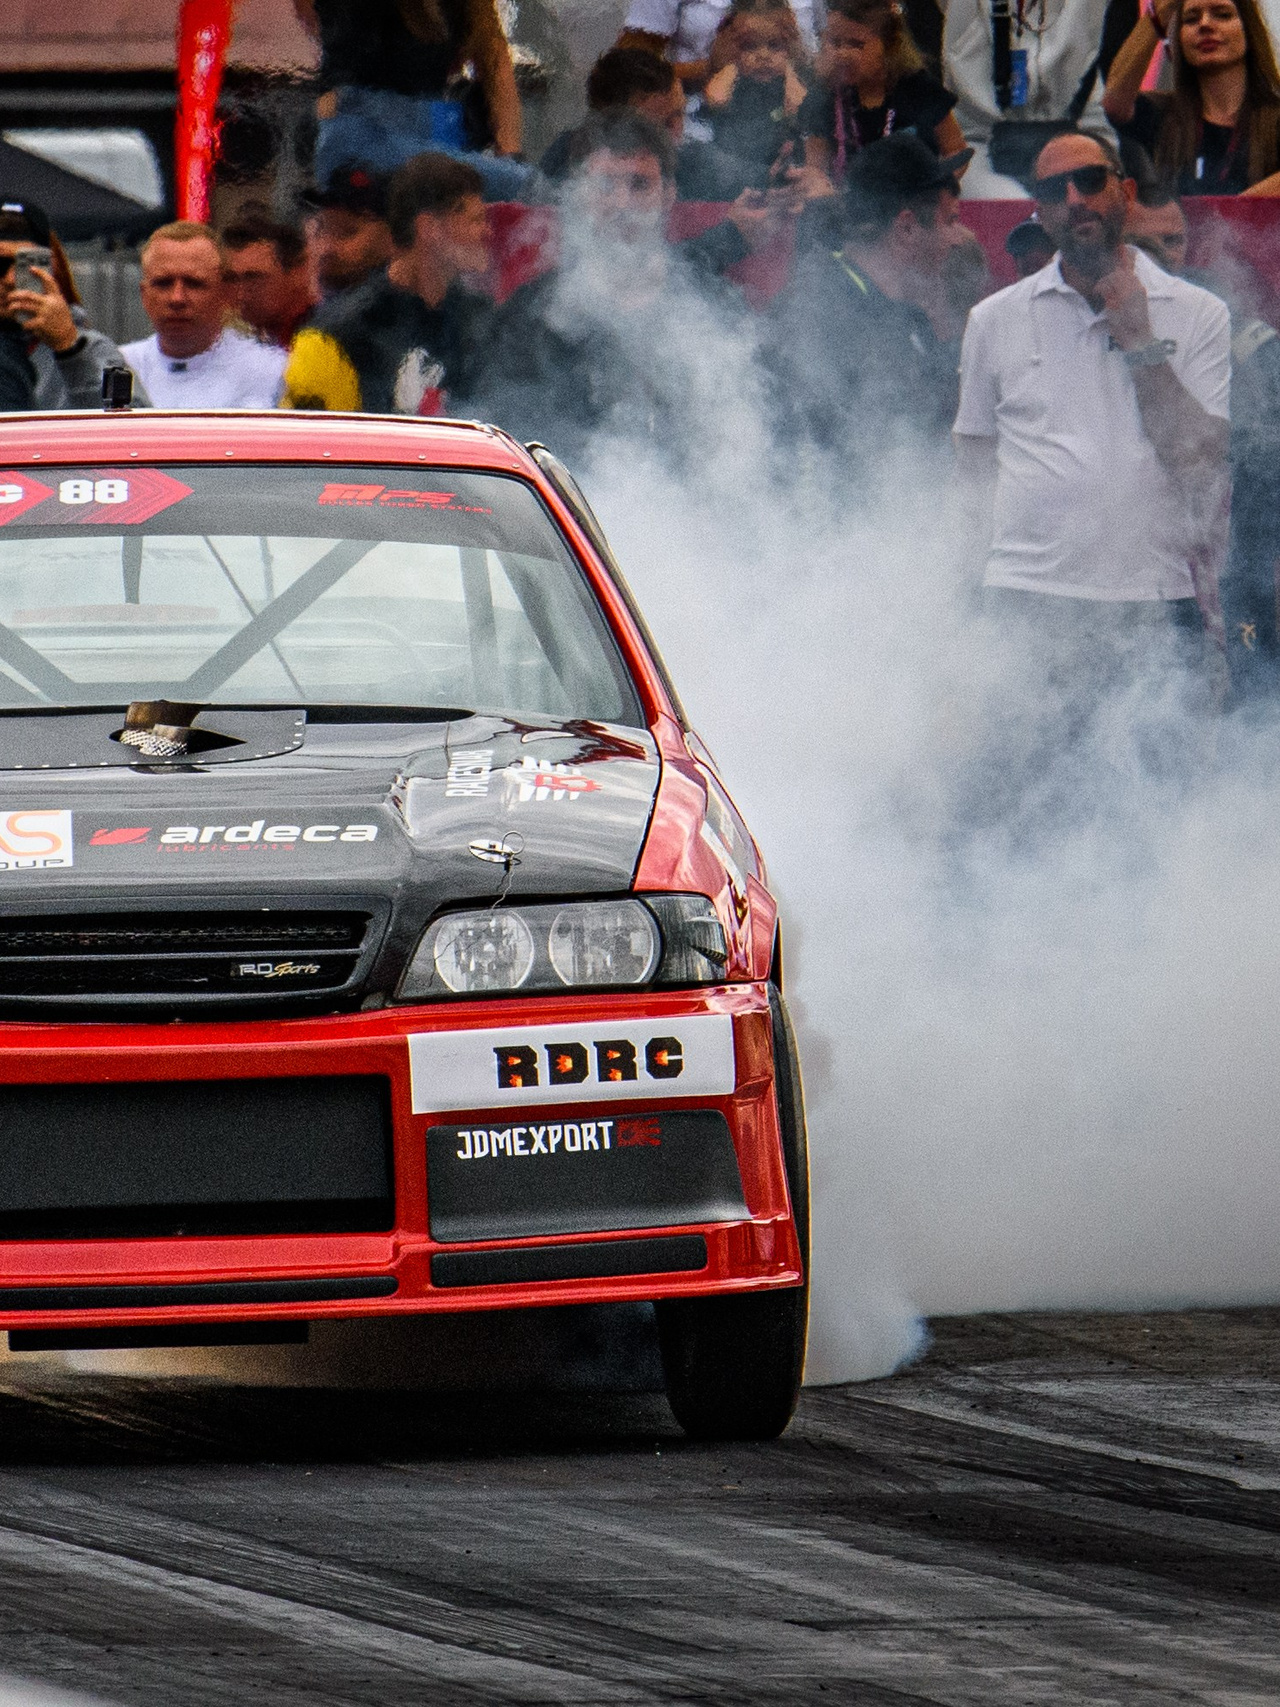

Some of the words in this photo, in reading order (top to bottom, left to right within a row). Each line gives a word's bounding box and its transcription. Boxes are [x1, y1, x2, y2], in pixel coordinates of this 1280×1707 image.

[59, 479, 129, 504] 88
[160, 820, 378, 843] ardeca
[493, 1036, 684, 1089] RDRC
[457, 1121, 613, 1159] JDMEXPORT
